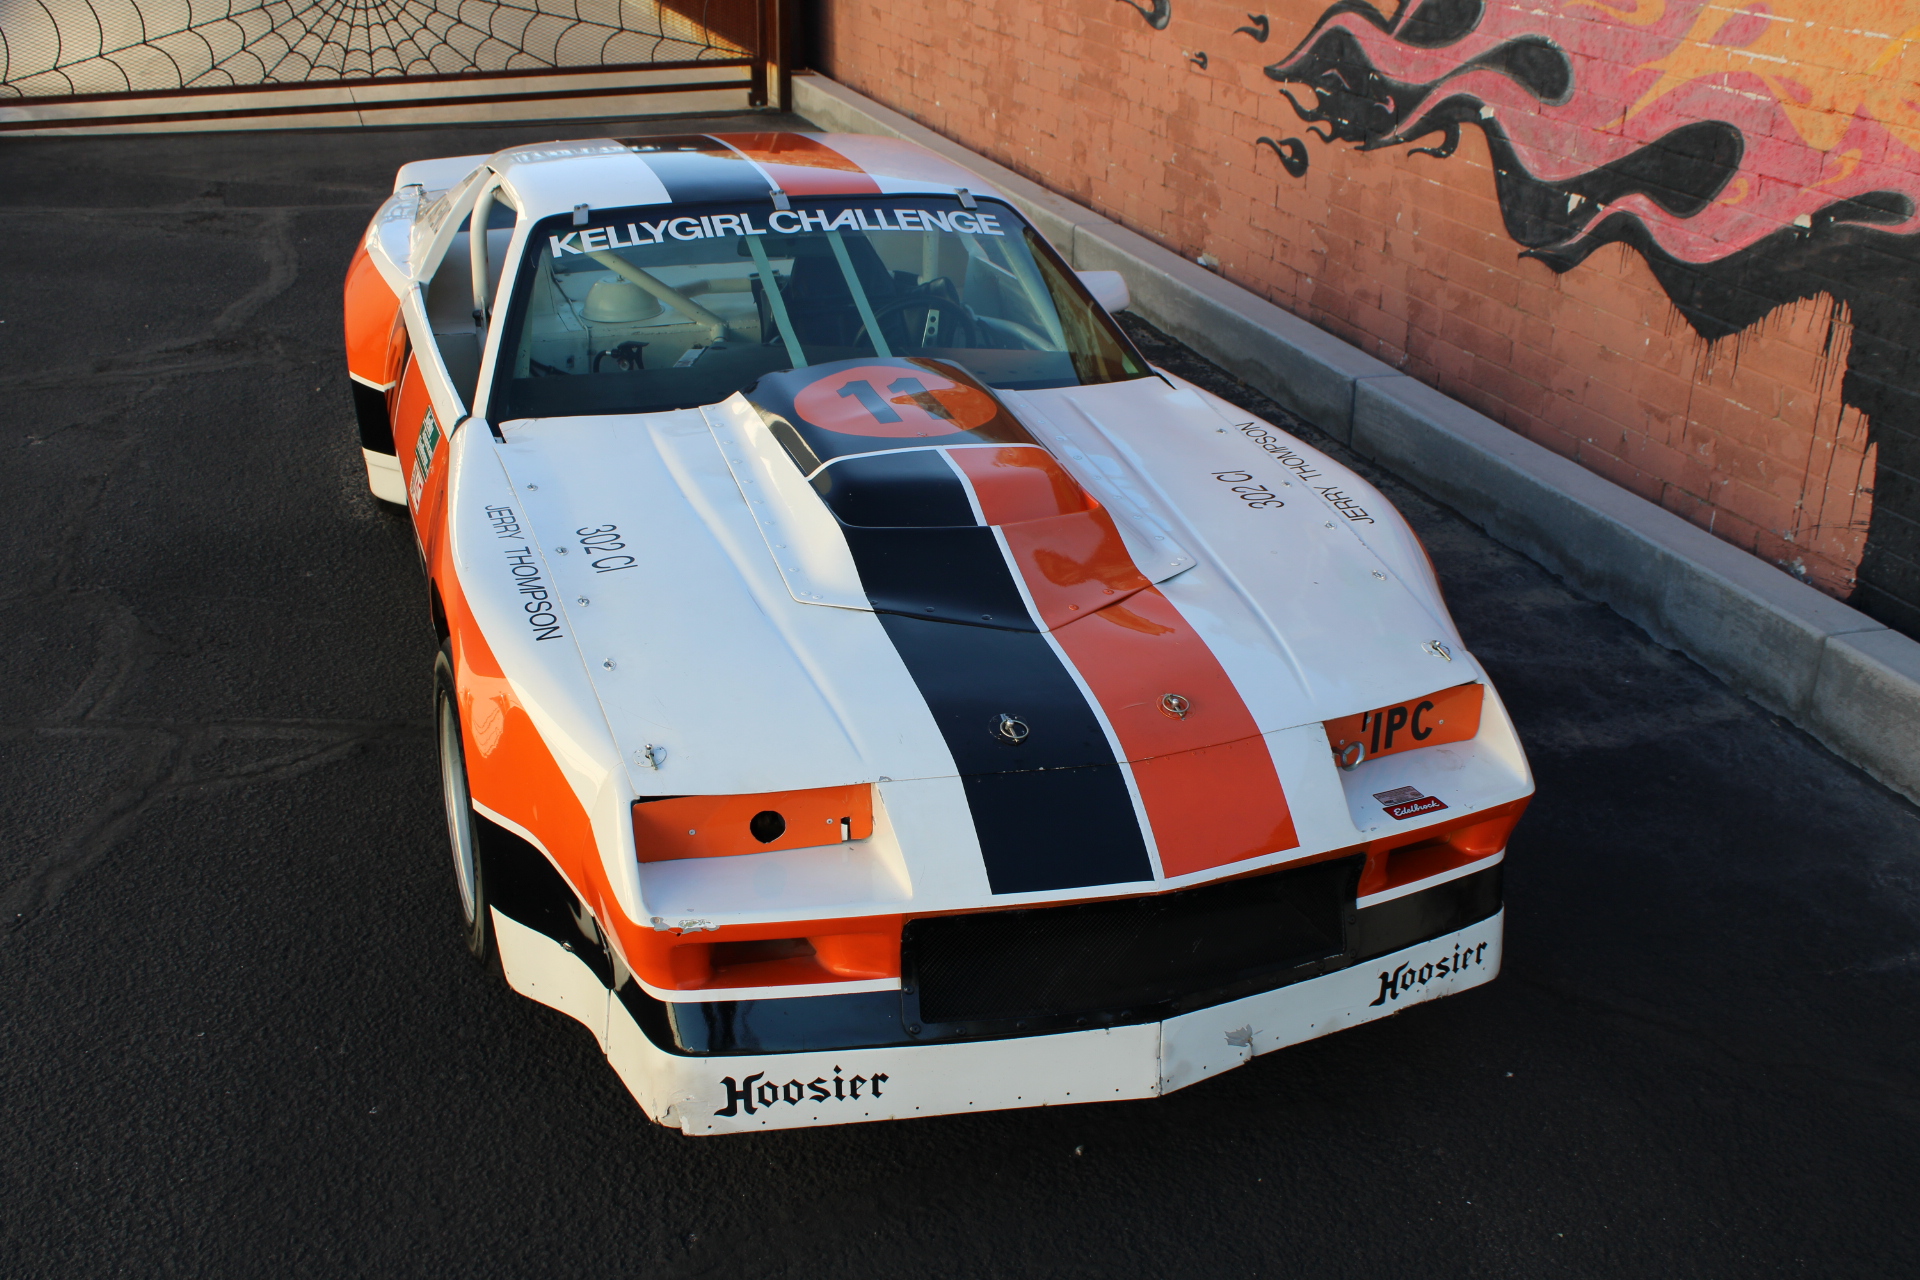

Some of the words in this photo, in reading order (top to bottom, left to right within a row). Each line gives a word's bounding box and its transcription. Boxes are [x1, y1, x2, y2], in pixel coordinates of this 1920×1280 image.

[549, 213, 767, 258] KELLYGIRL
[768, 208, 1005, 236] CHALLENGE
[836, 377, 955, 424] 11
[1235, 422, 1322, 481] THOMPSON
[1211, 470, 1253, 483] CI
[1231, 484, 1285, 509] 302
[1313, 486, 1375, 524] JERRY
[485, 504, 525, 540] JERRY
[576, 524, 626, 555] 302
[591, 555, 638, 573] CI
[504, 546, 563, 641] THOMPSON
[1393, 800, 1440, 817] Edelbrock
[1368, 941, 1488, 1007] Hoosier
[713, 1064, 889, 1117] Hoosier
